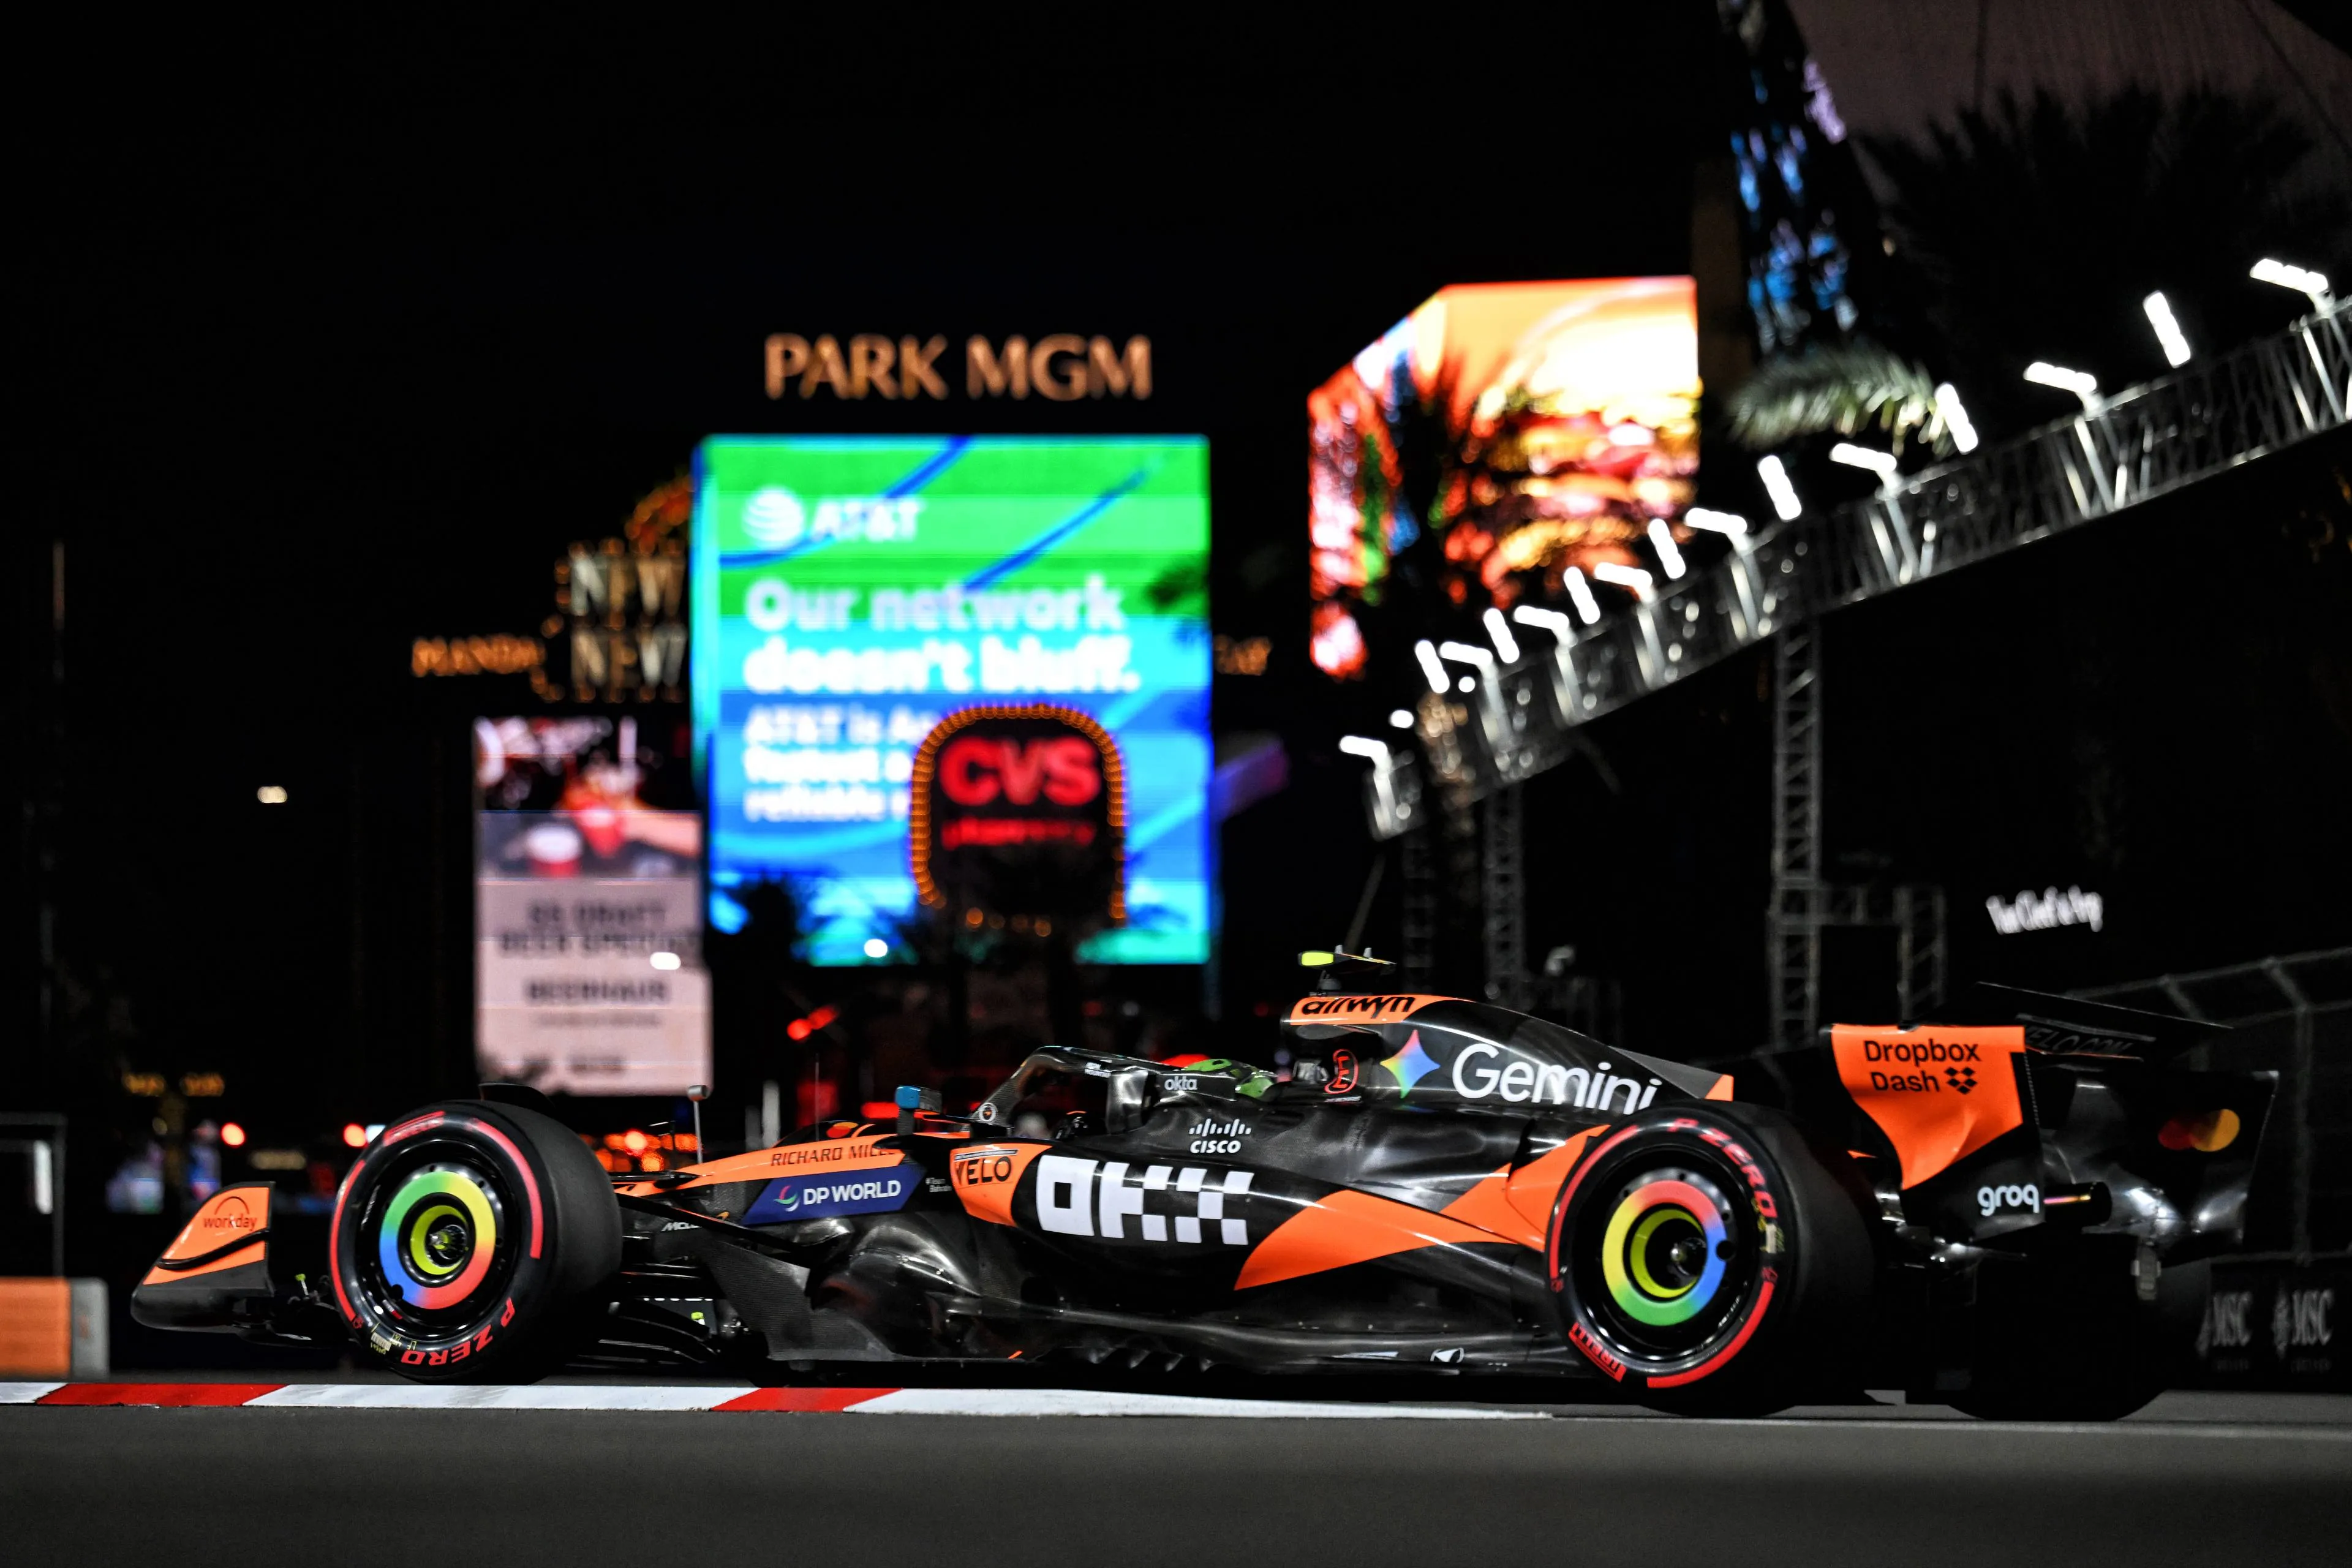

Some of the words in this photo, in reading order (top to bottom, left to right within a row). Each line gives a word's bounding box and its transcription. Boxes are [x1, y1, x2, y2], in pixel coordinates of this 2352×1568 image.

[763, 333, 949, 400] PARK
[965, 333, 1153, 401] MGM
[810, 494, 923, 542] AT&T
[745, 578, 859, 631] Our
[870, 572, 1127, 631] network
[743, 636, 974, 694] doesn't
[980, 635, 1142, 694] bluff.
[745, 706, 844, 746] AT&T
[848, 704, 884, 745] is
[938, 736, 1102, 808] CVS
[1301, 997, 1416, 1019] allwyn
[1864, 1038, 1981, 1067] Dropbox
[1164, 1076, 1197, 1091] okta
[1452, 1042, 1662, 1115] Gemini
[1871, 1070, 1940, 1091] Dash
[771, 1147, 843, 1167] RICHARD
[955, 1156, 1011, 1186] VELO
[1697, 1127, 1777, 1218] ZERO
[803, 1187, 829, 1205] DP
[832, 1180, 902, 1202] WORLD
[1036, 1155, 1254, 1245] OKX
[1977, 1184, 2040, 1216] groq
[203, 1213, 258, 1232] workday
[500, 1297, 516, 1328] P
[401, 1324, 494, 1366] ZERO
